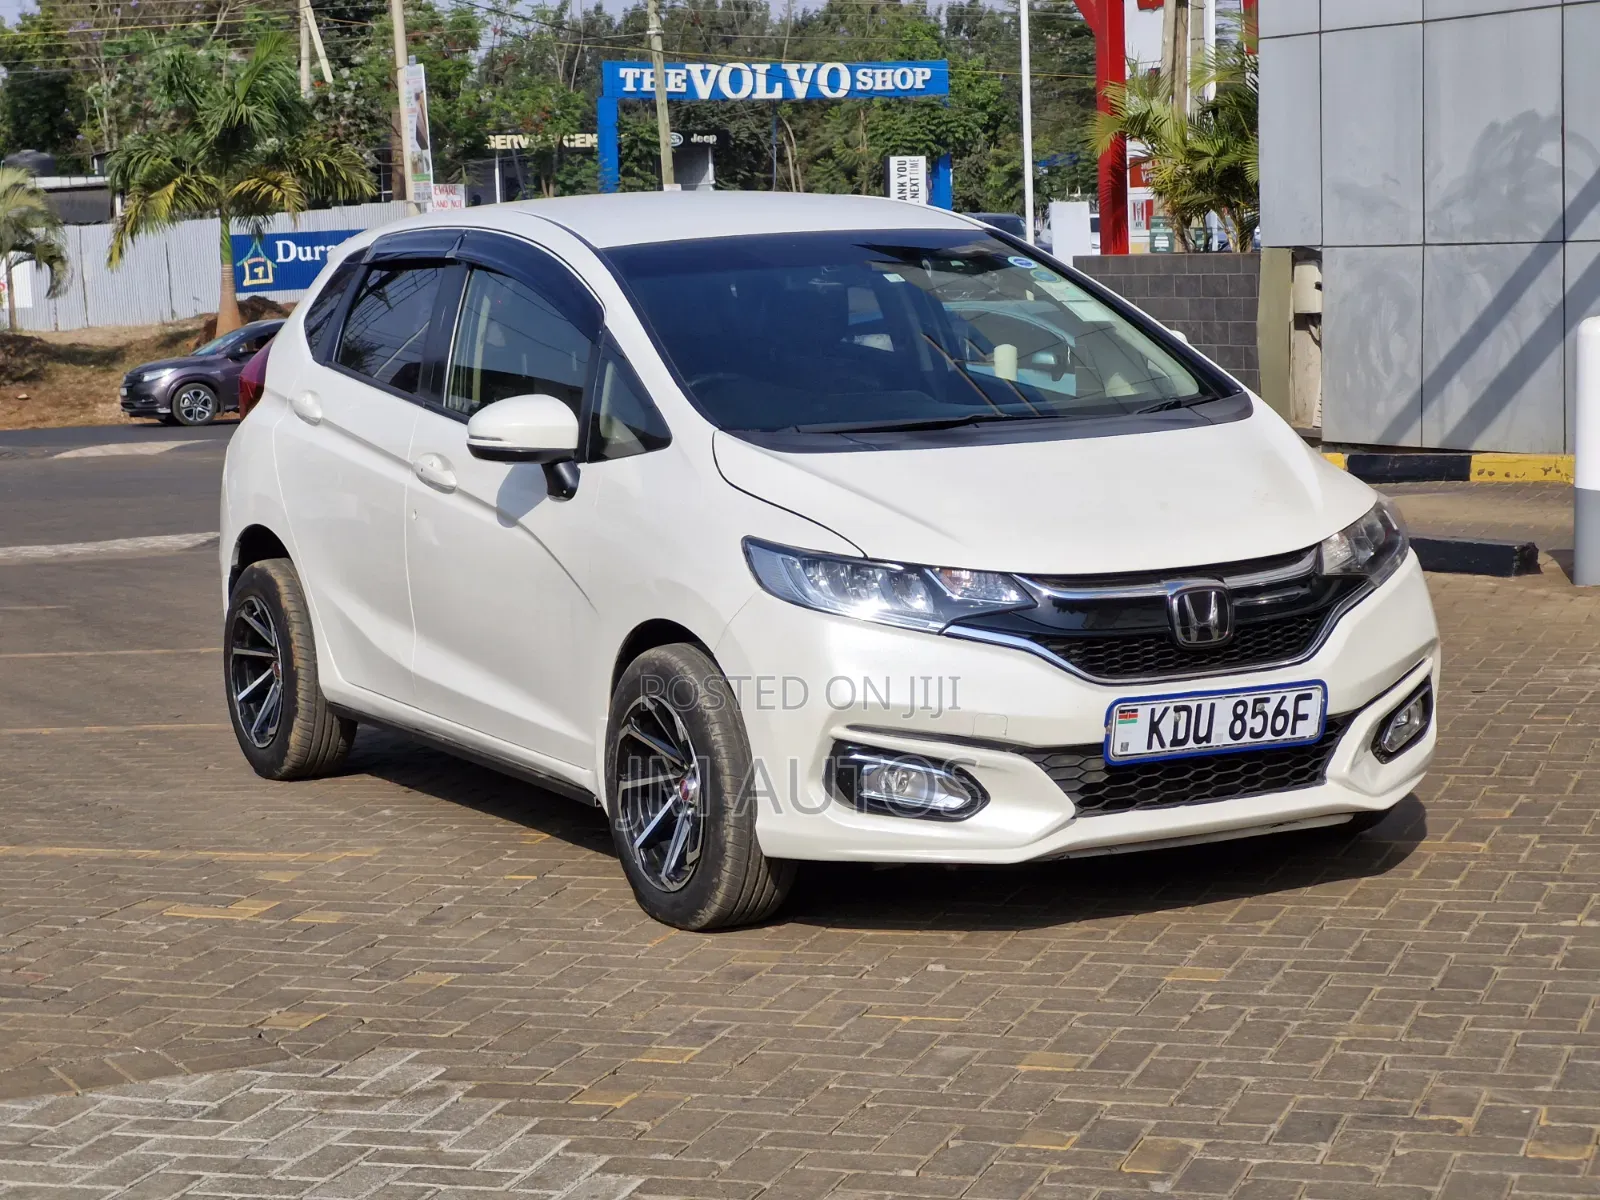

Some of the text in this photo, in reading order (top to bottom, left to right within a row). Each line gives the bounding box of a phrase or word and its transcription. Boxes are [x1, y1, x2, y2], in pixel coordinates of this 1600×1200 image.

[685, 62, 851, 100] VOLVO
[856, 67, 932, 91] SHOP
[690, 133, 717, 145] Jeep
[897, 160, 907, 201] ANK YOU
[909, 177, 920, 199] NEXT
[1147, 693, 1313, 750] KDU 856F
